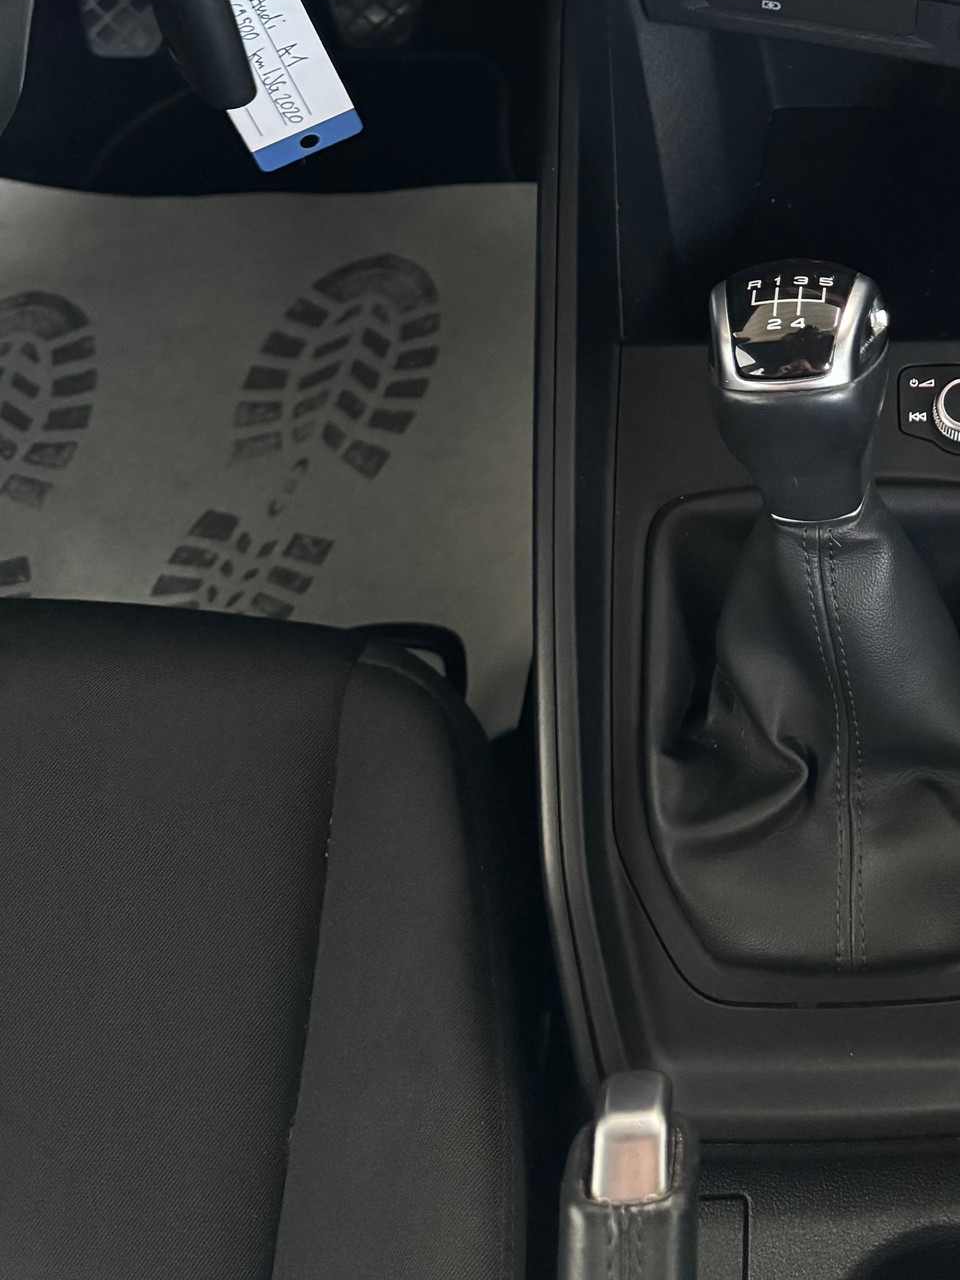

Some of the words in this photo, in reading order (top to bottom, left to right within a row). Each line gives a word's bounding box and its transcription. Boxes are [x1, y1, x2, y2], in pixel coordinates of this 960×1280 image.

[277, 42, 310, 68] A1
[274, 93, 304, 124] 2020
[774, 276, 781, 286] 1
[793, 276, 809, 286] 3
[818, 277, 834, 287] 5
[767, 318, 782, 330] 2
[790, 317, 806, 329] 4
